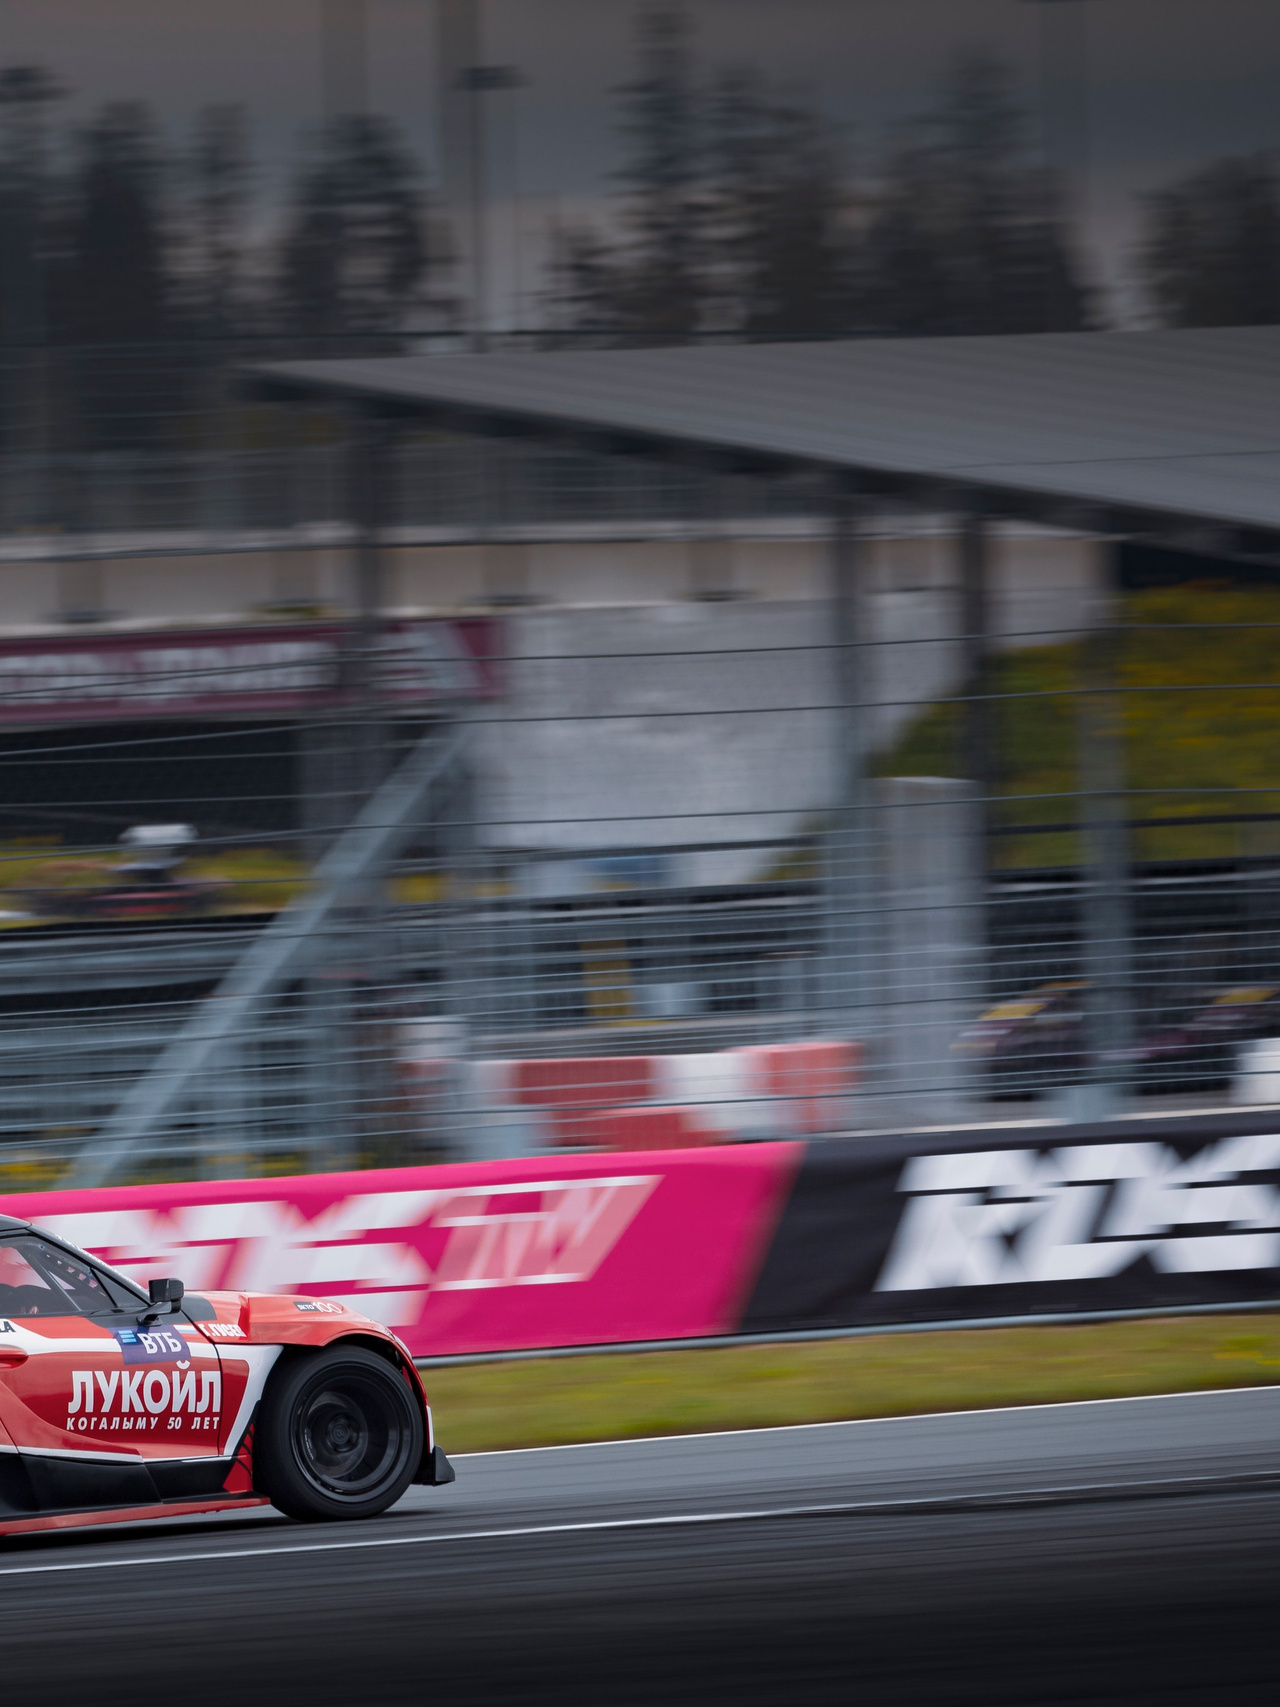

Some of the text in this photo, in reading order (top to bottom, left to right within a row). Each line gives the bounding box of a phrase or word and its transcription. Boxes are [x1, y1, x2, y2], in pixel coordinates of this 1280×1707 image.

[136, 1332, 182, 1354] ВТБ
[68, 1360, 221, 1414] ЛУКОЙЛ
[66, 1416, 220, 1430] КОГАЛЫМУ 50 ЛЕТ
